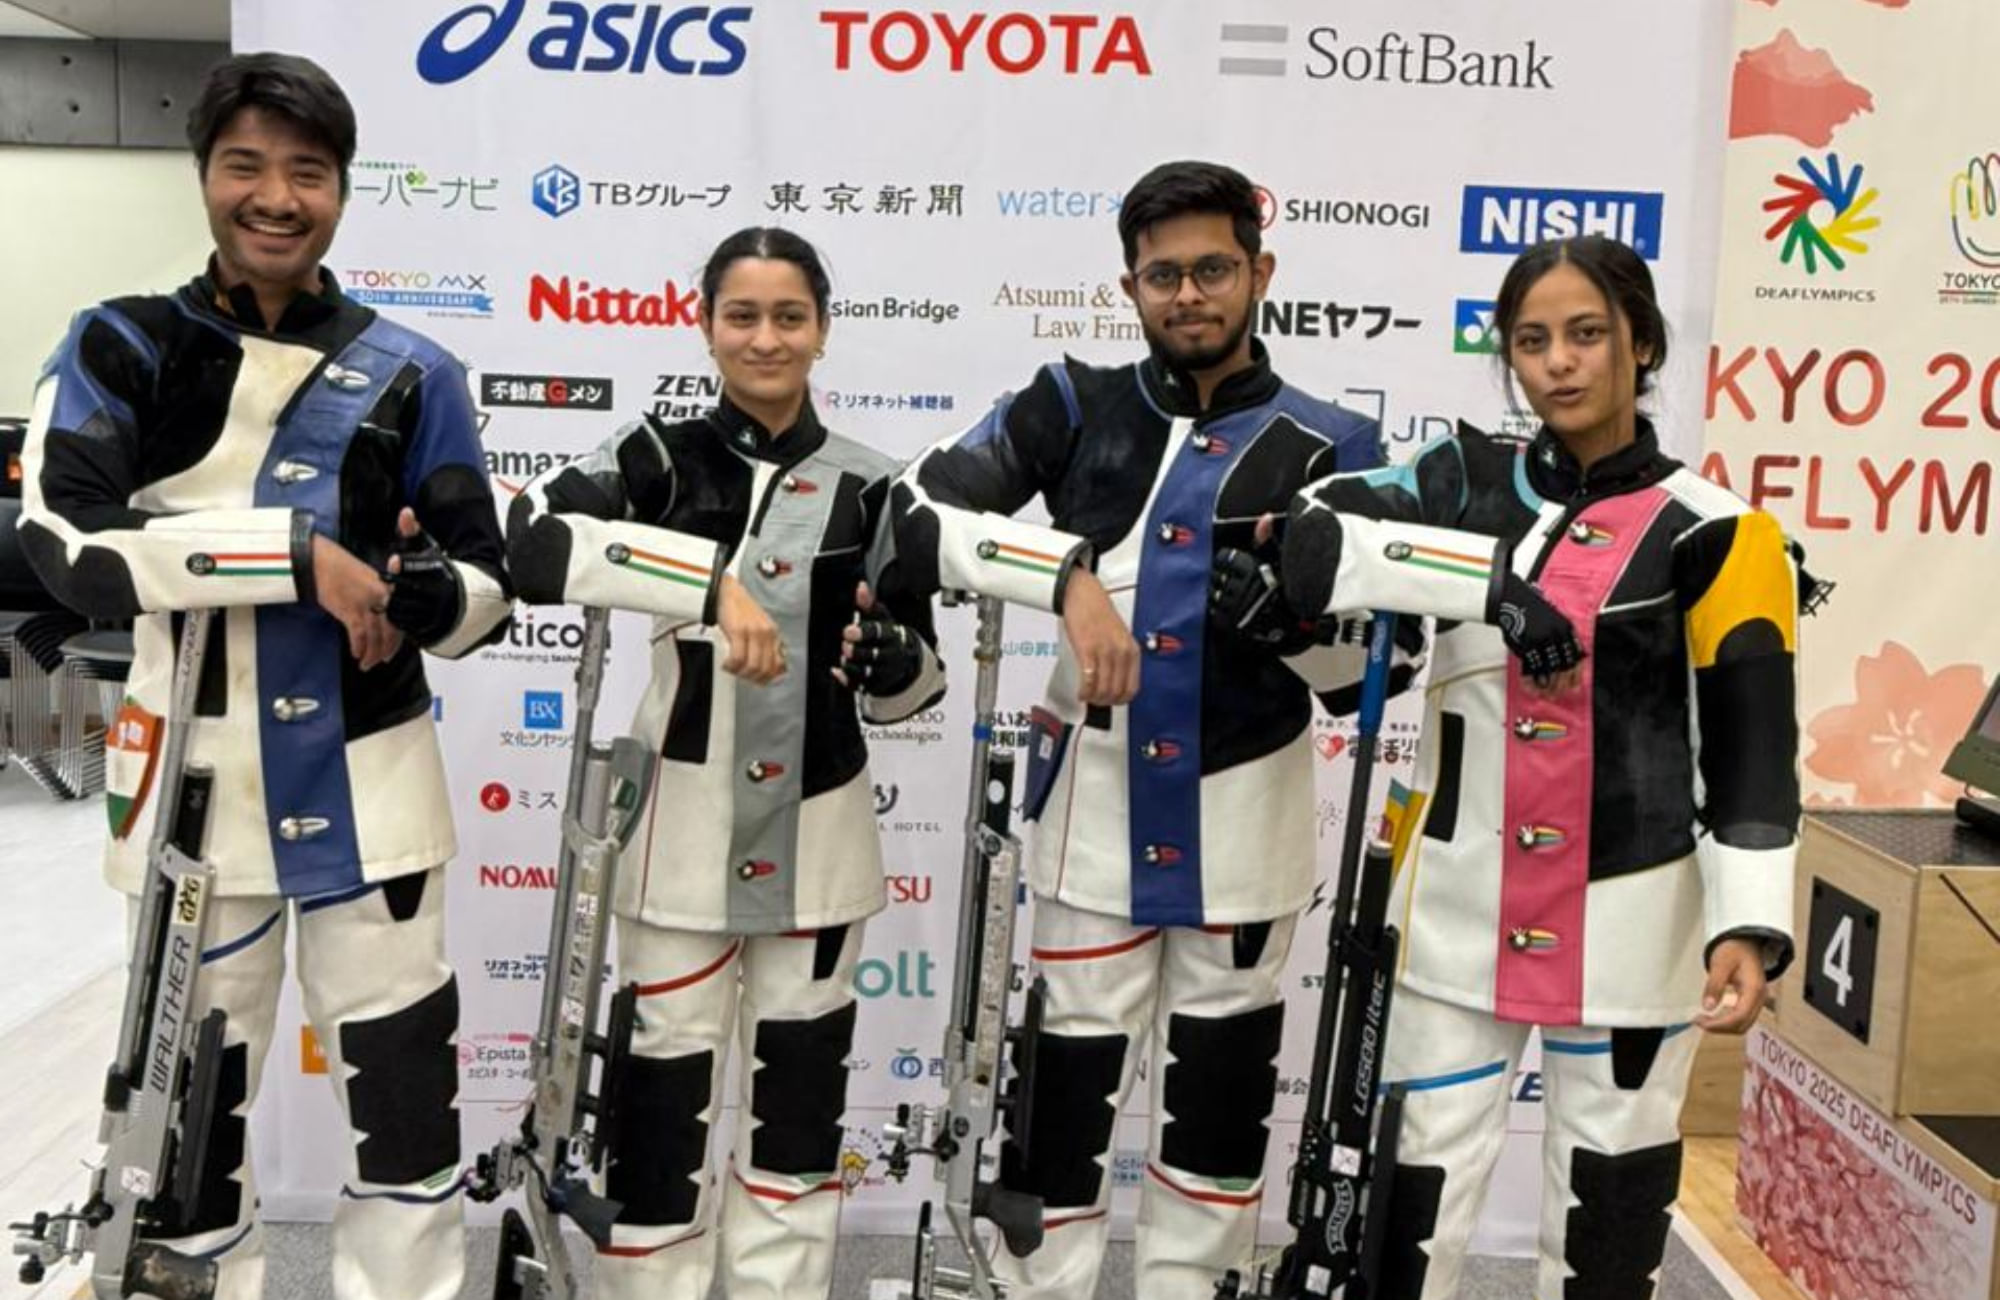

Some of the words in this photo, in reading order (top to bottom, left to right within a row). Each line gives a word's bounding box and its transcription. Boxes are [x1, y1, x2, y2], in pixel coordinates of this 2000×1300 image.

[527, 1, 753, 77] asics
[820, 10, 1153, 76] TOYOTA
[1305, 26, 1555, 89] SoftBank
[588, 181, 731, 209] TBグループ
[765, 181, 964, 218] 東京新聞
[1285, 199, 1429, 229] SHIONOGI
[1480, 196, 1636, 248] NISHI
[346, 270, 431, 289] TOKYO
[437, 274, 486, 290] MX
[994, 281, 1085, 308] Atsumi
[1091, 283, 1116, 308] &
[1755, 286, 1876, 303] DEAFLYMPICS
[831, 299, 879, 319] sian
[883, 296, 960, 324] Bridge
[1033, 314, 1086, 339] Law
[1094, 314, 1140, 341] Firm
[653, 374, 721, 398] ZEN
[1703, 345, 1886, 427] KYO
[484, 449, 597, 477] amaz
[509, 612, 610, 649] tico
[853, 951, 935, 998] olt
[1822, 914, 1853, 1007] 4
[150, 934, 192, 1094] WALTHER
[477, 1047, 526, 1063] Epista
[1758, 1031, 1807, 1086] TOKYO
[1809, 1069, 1847, 1122] 2025
[1849, 1101, 1977, 1227] DEAFLYMPICS
